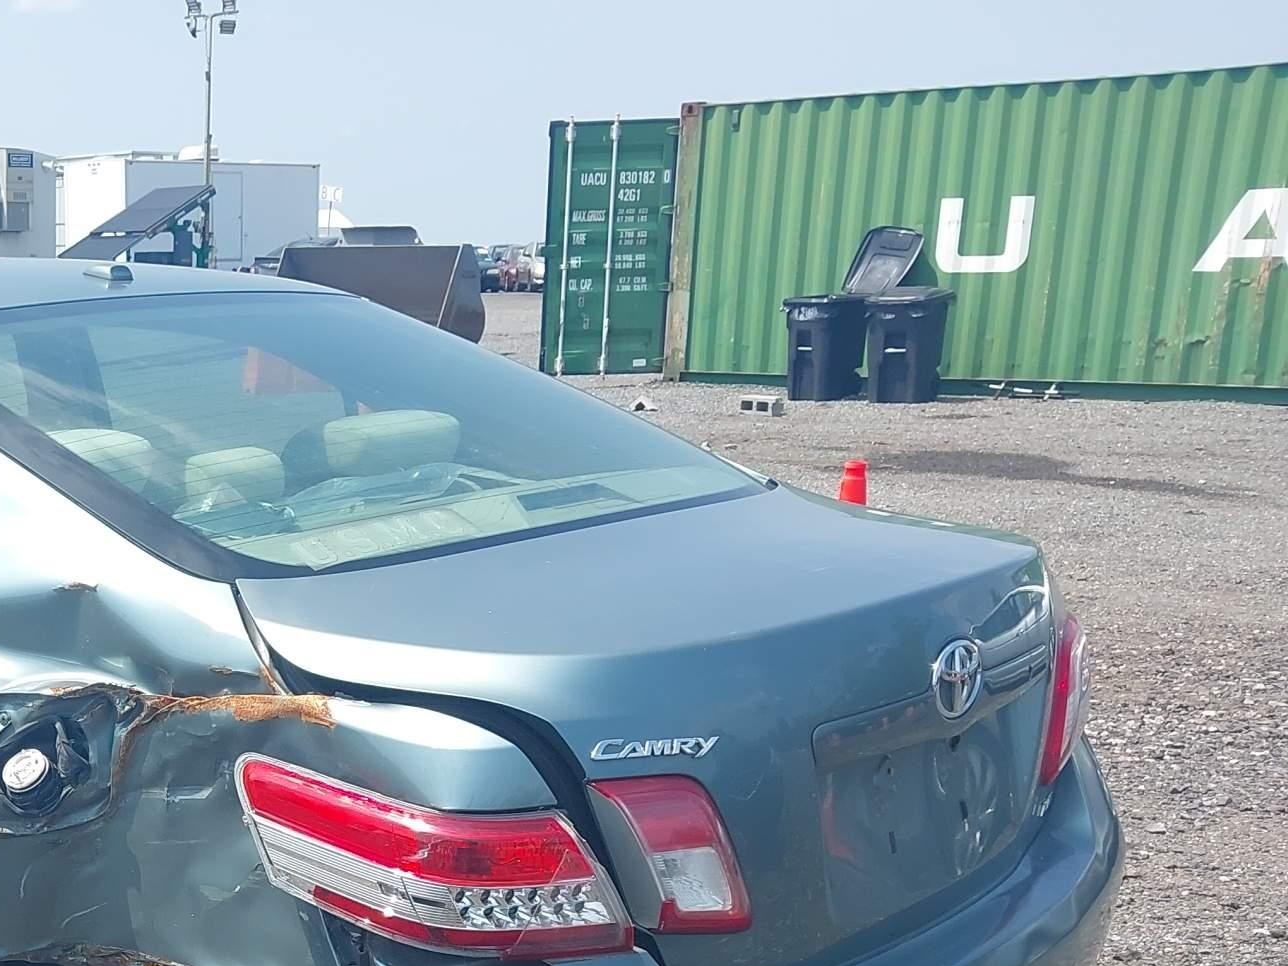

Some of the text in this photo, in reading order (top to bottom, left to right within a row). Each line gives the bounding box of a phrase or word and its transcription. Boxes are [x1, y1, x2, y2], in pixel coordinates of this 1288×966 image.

[581, 173, 607, 186] UACU
[619, 171, 655, 184] 830182
[618, 189, 641, 202] 42G1
[934, 187, 1288, 273] U A
[590, 735, 719, 761] CAMRY
